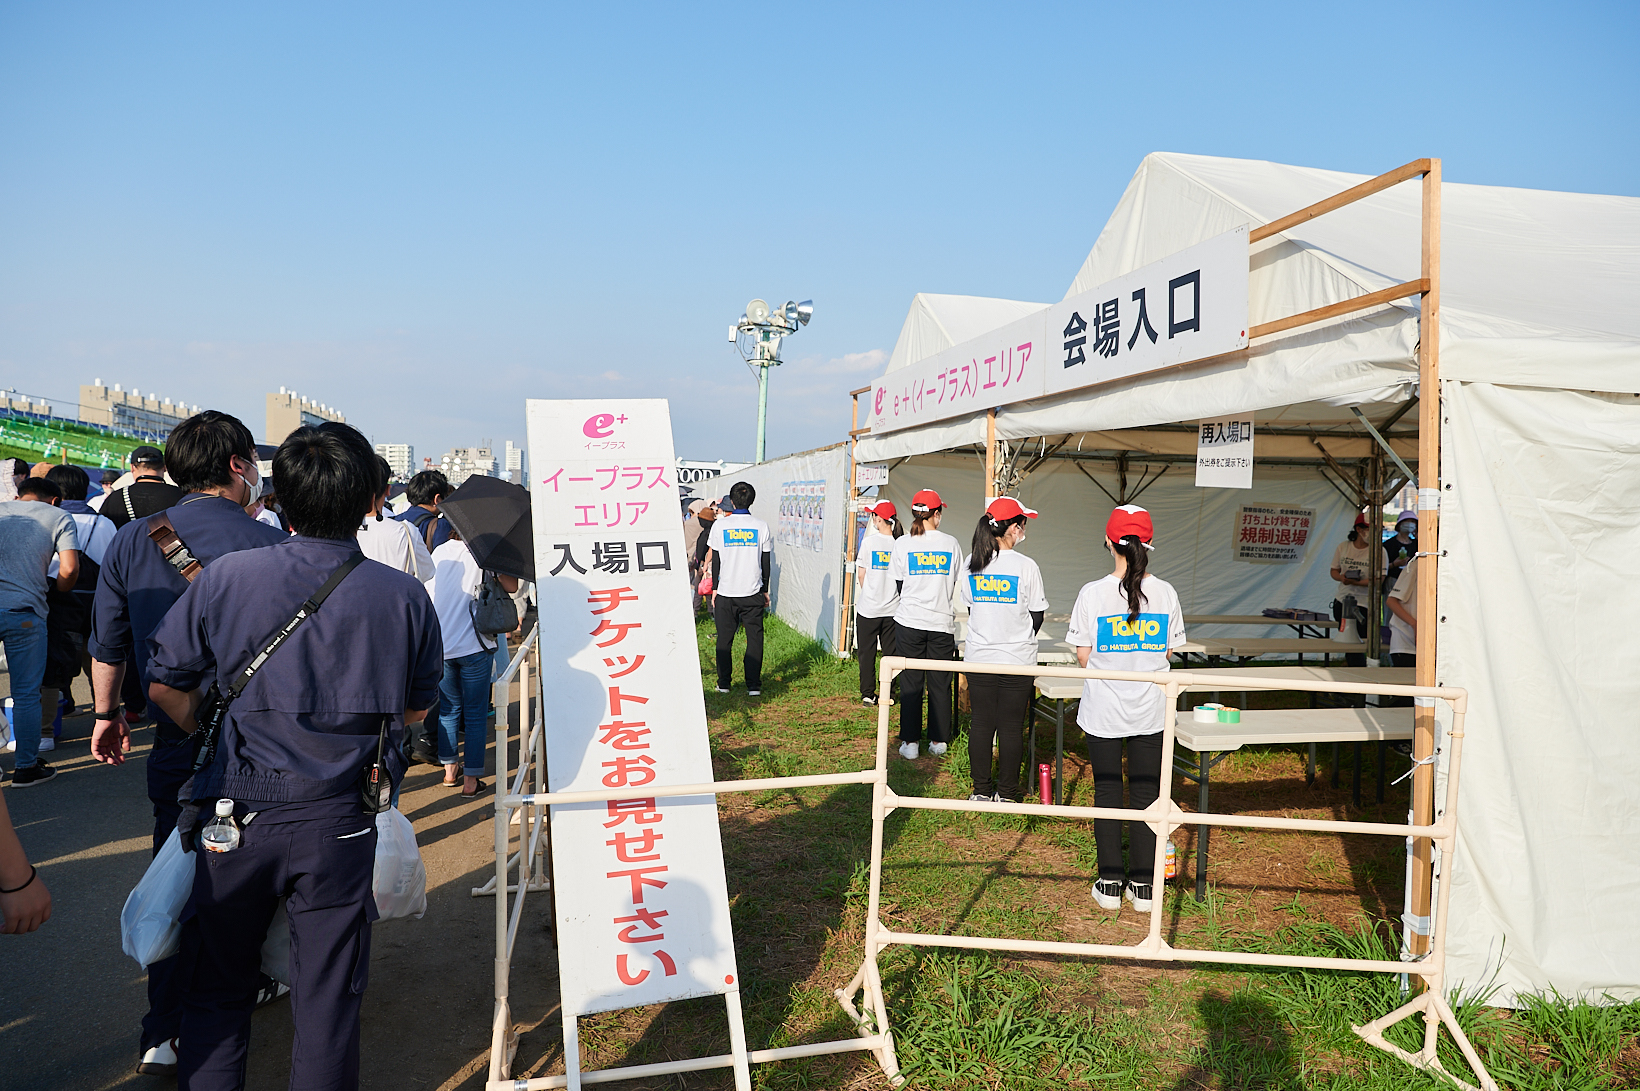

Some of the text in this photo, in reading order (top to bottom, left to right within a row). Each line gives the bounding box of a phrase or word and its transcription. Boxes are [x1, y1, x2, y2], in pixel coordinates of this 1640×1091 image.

[1063, 269, 1200, 369] 会場入口
[1201, 421, 1251, 444] 再入場口
[584, 441, 626, 451] イープラス
[1199, 457, 1251, 468] 外出券をご提示下さい
[542, 465, 671, 493] イープラス
[677, 467, 715, 484] OOD
[574, 501, 650, 528] エリア
[1242, 514, 1310, 528] 打ち上げ終了後
[727, 529, 754, 542] Taiyo
[1239, 526, 1308, 546] 規制退場
[549, 541, 672, 577] 入場口
[876, 551, 891, 563] Tai
[913, 552, 948, 568] Taiyo
[973, 575, 1011, 596] Taiyo
[1109, 642, 1166, 651] HATSUTA GROUP
[586, 586, 678, 987] チケットをお見せ下さい
